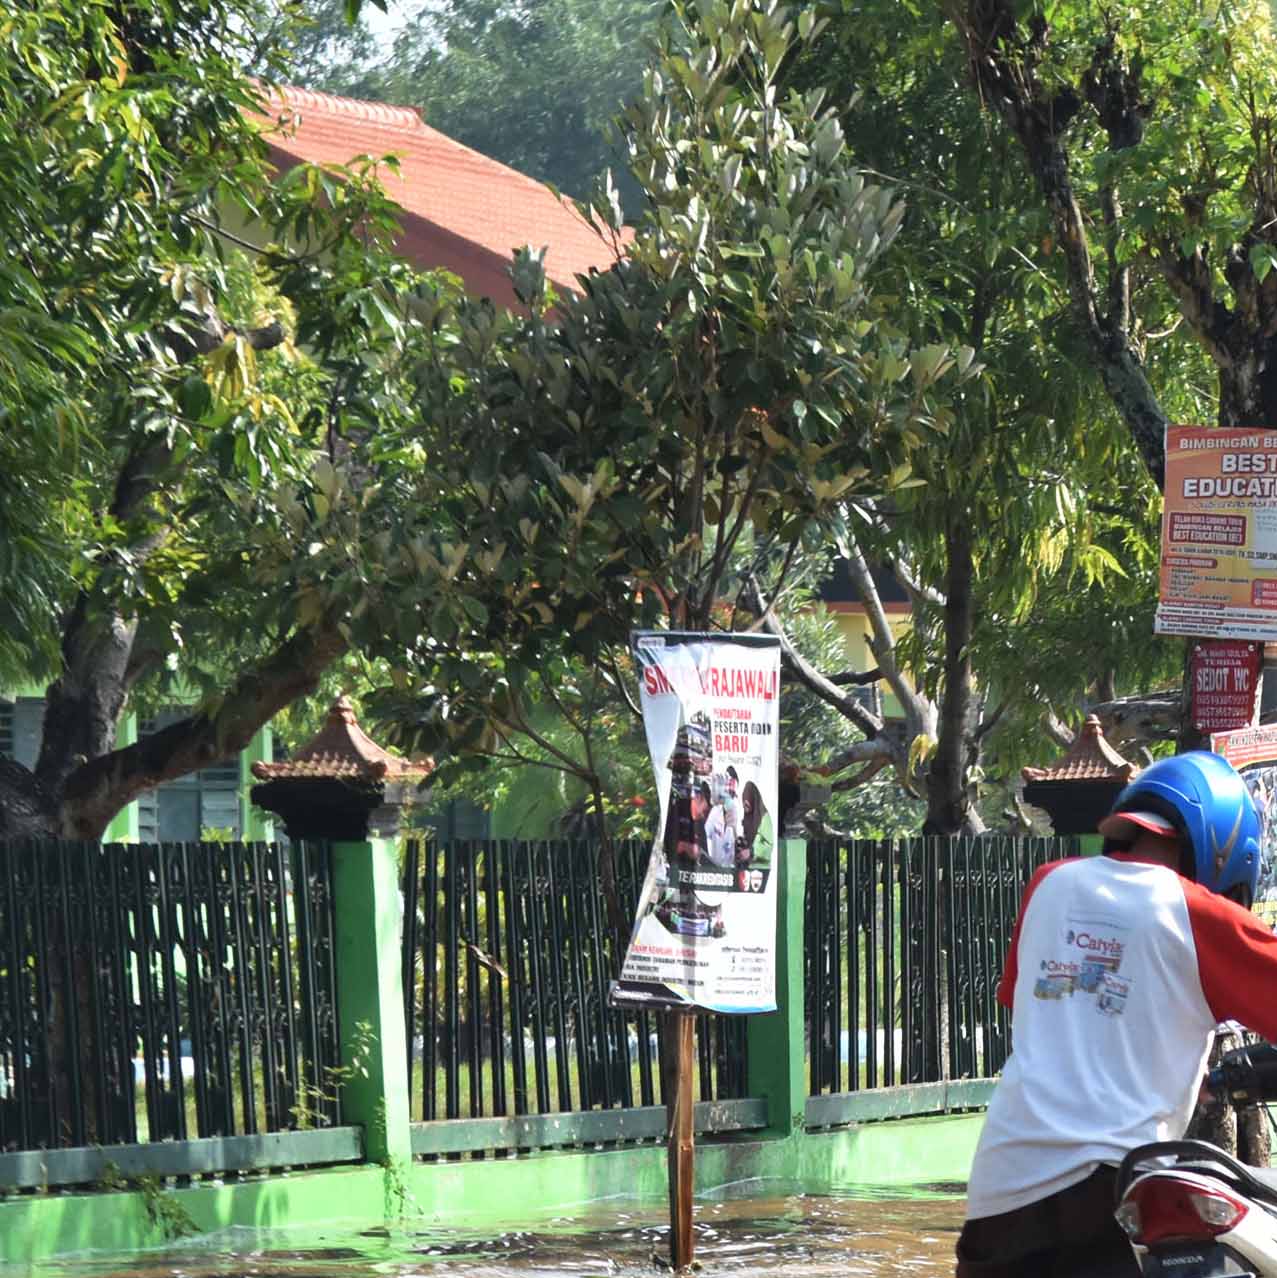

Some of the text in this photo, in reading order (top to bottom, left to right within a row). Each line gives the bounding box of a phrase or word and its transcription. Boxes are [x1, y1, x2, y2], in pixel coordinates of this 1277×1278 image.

[1179, 437, 1259, 449] BIMBINGAN
[1173, 531, 1190, 541] BEST
[1190, 532, 1228, 542] EDUCATION
[711, 666, 777, 701] RAJAWALI
[1196, 668, 1250, 692] SEDOT WC
[714, 720, 749, 735] PESERTA
[715, 734, 748, 753] BARU
